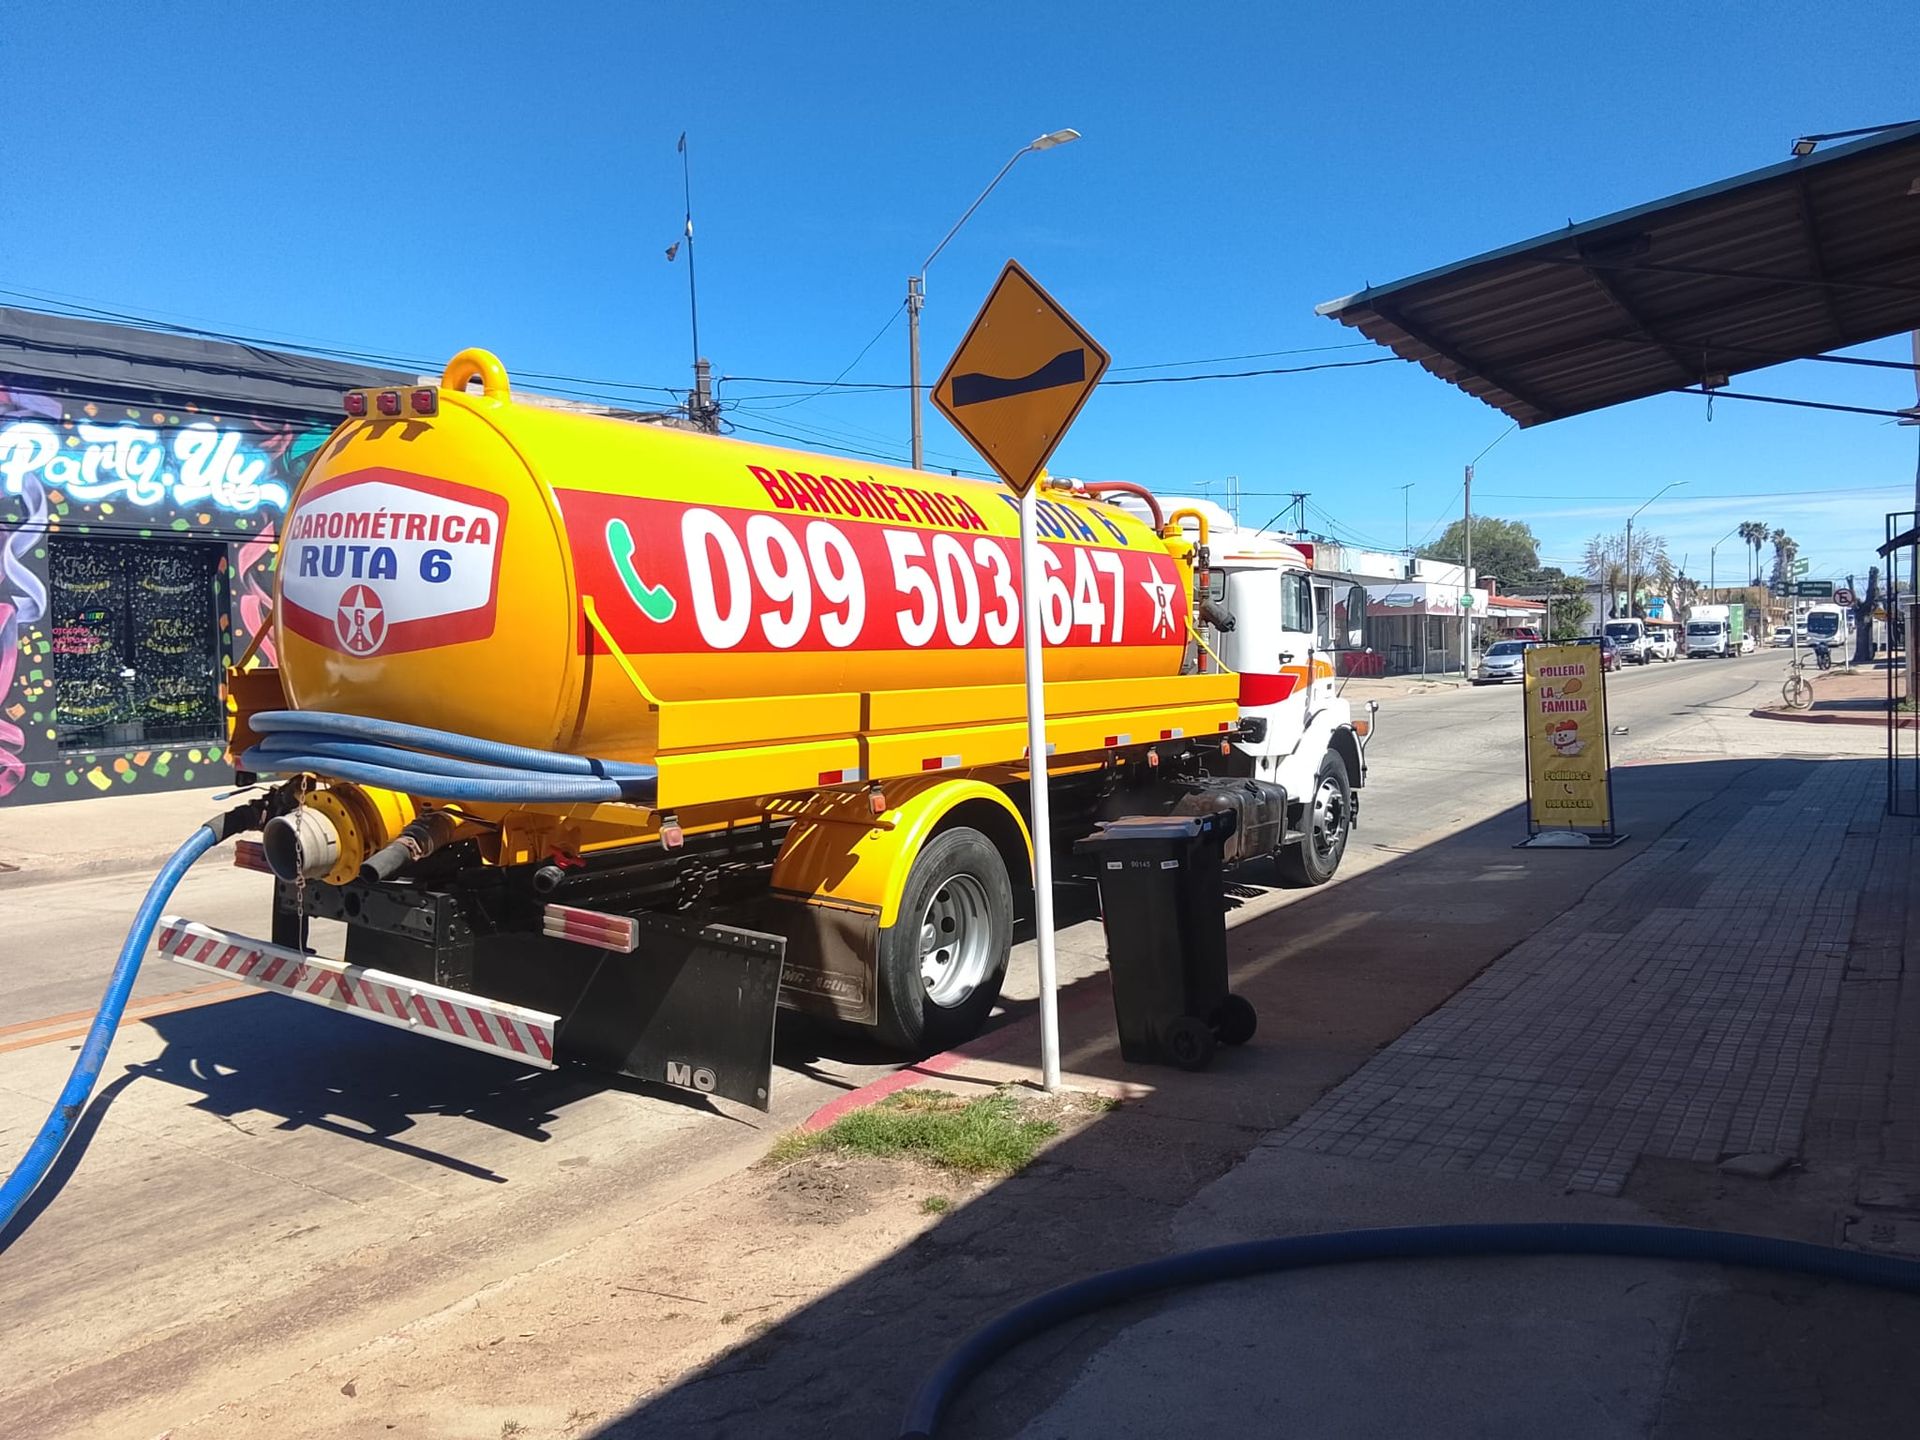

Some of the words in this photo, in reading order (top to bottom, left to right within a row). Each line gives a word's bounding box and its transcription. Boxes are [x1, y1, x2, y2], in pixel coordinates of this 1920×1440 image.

[746, 463, 989, 532] BAROMÉTRICA
[291, 507, 491, 545] BAROMÉTRICA
[1087, 507, 1128, 546] 6
[299, 545, 397, 580] RUTA
[420, 548, 453, 583] 6
[680, 507, 866, 650] 099
[883, 528, 1021, 648] 503
[1037, 541, 1125, 646] 647
[1540, 664, 1586, 678] POLLERÍA
[1541, 687, 1554, 698] LA
[1542, 700, 1588, 713] FAMILIA
